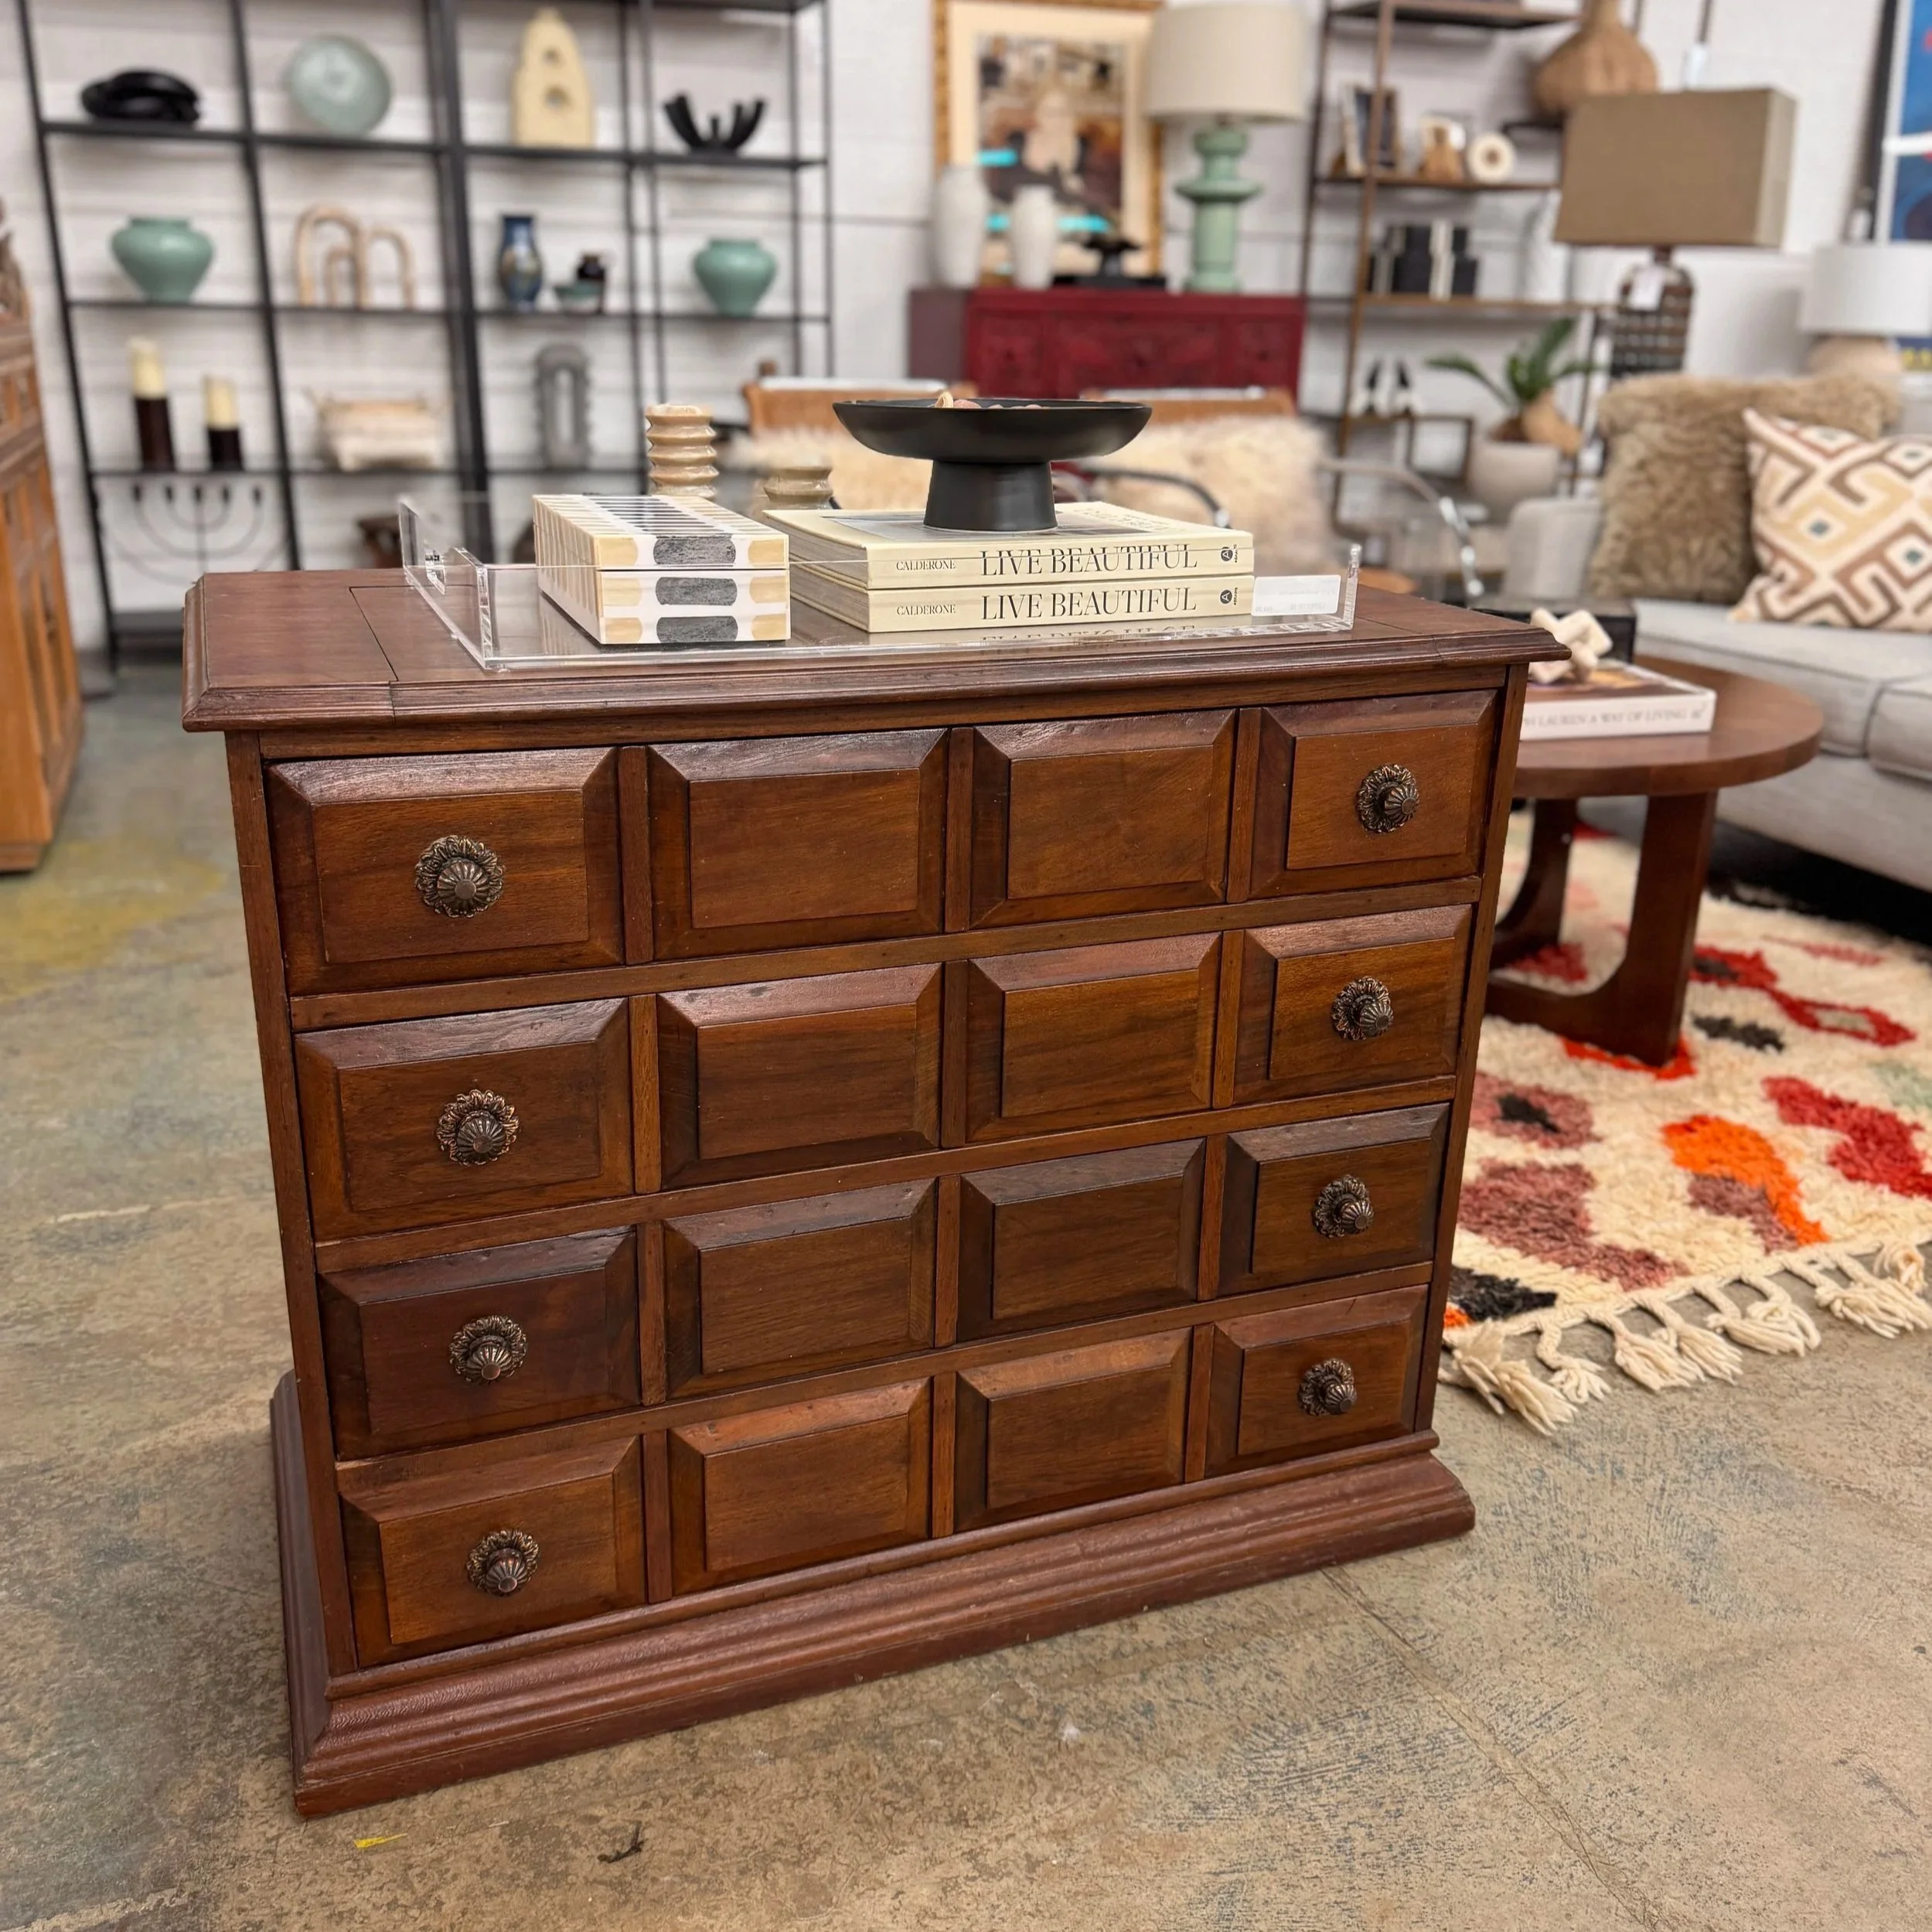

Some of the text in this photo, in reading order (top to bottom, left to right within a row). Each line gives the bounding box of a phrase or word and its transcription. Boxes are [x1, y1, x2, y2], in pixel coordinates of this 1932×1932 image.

[896, 543, 1198, 576] CALDERONE LIVE BEAUTIFUL
[897, 587, 1197, 620] CALDERONE LIVE BEAUTIFUL
